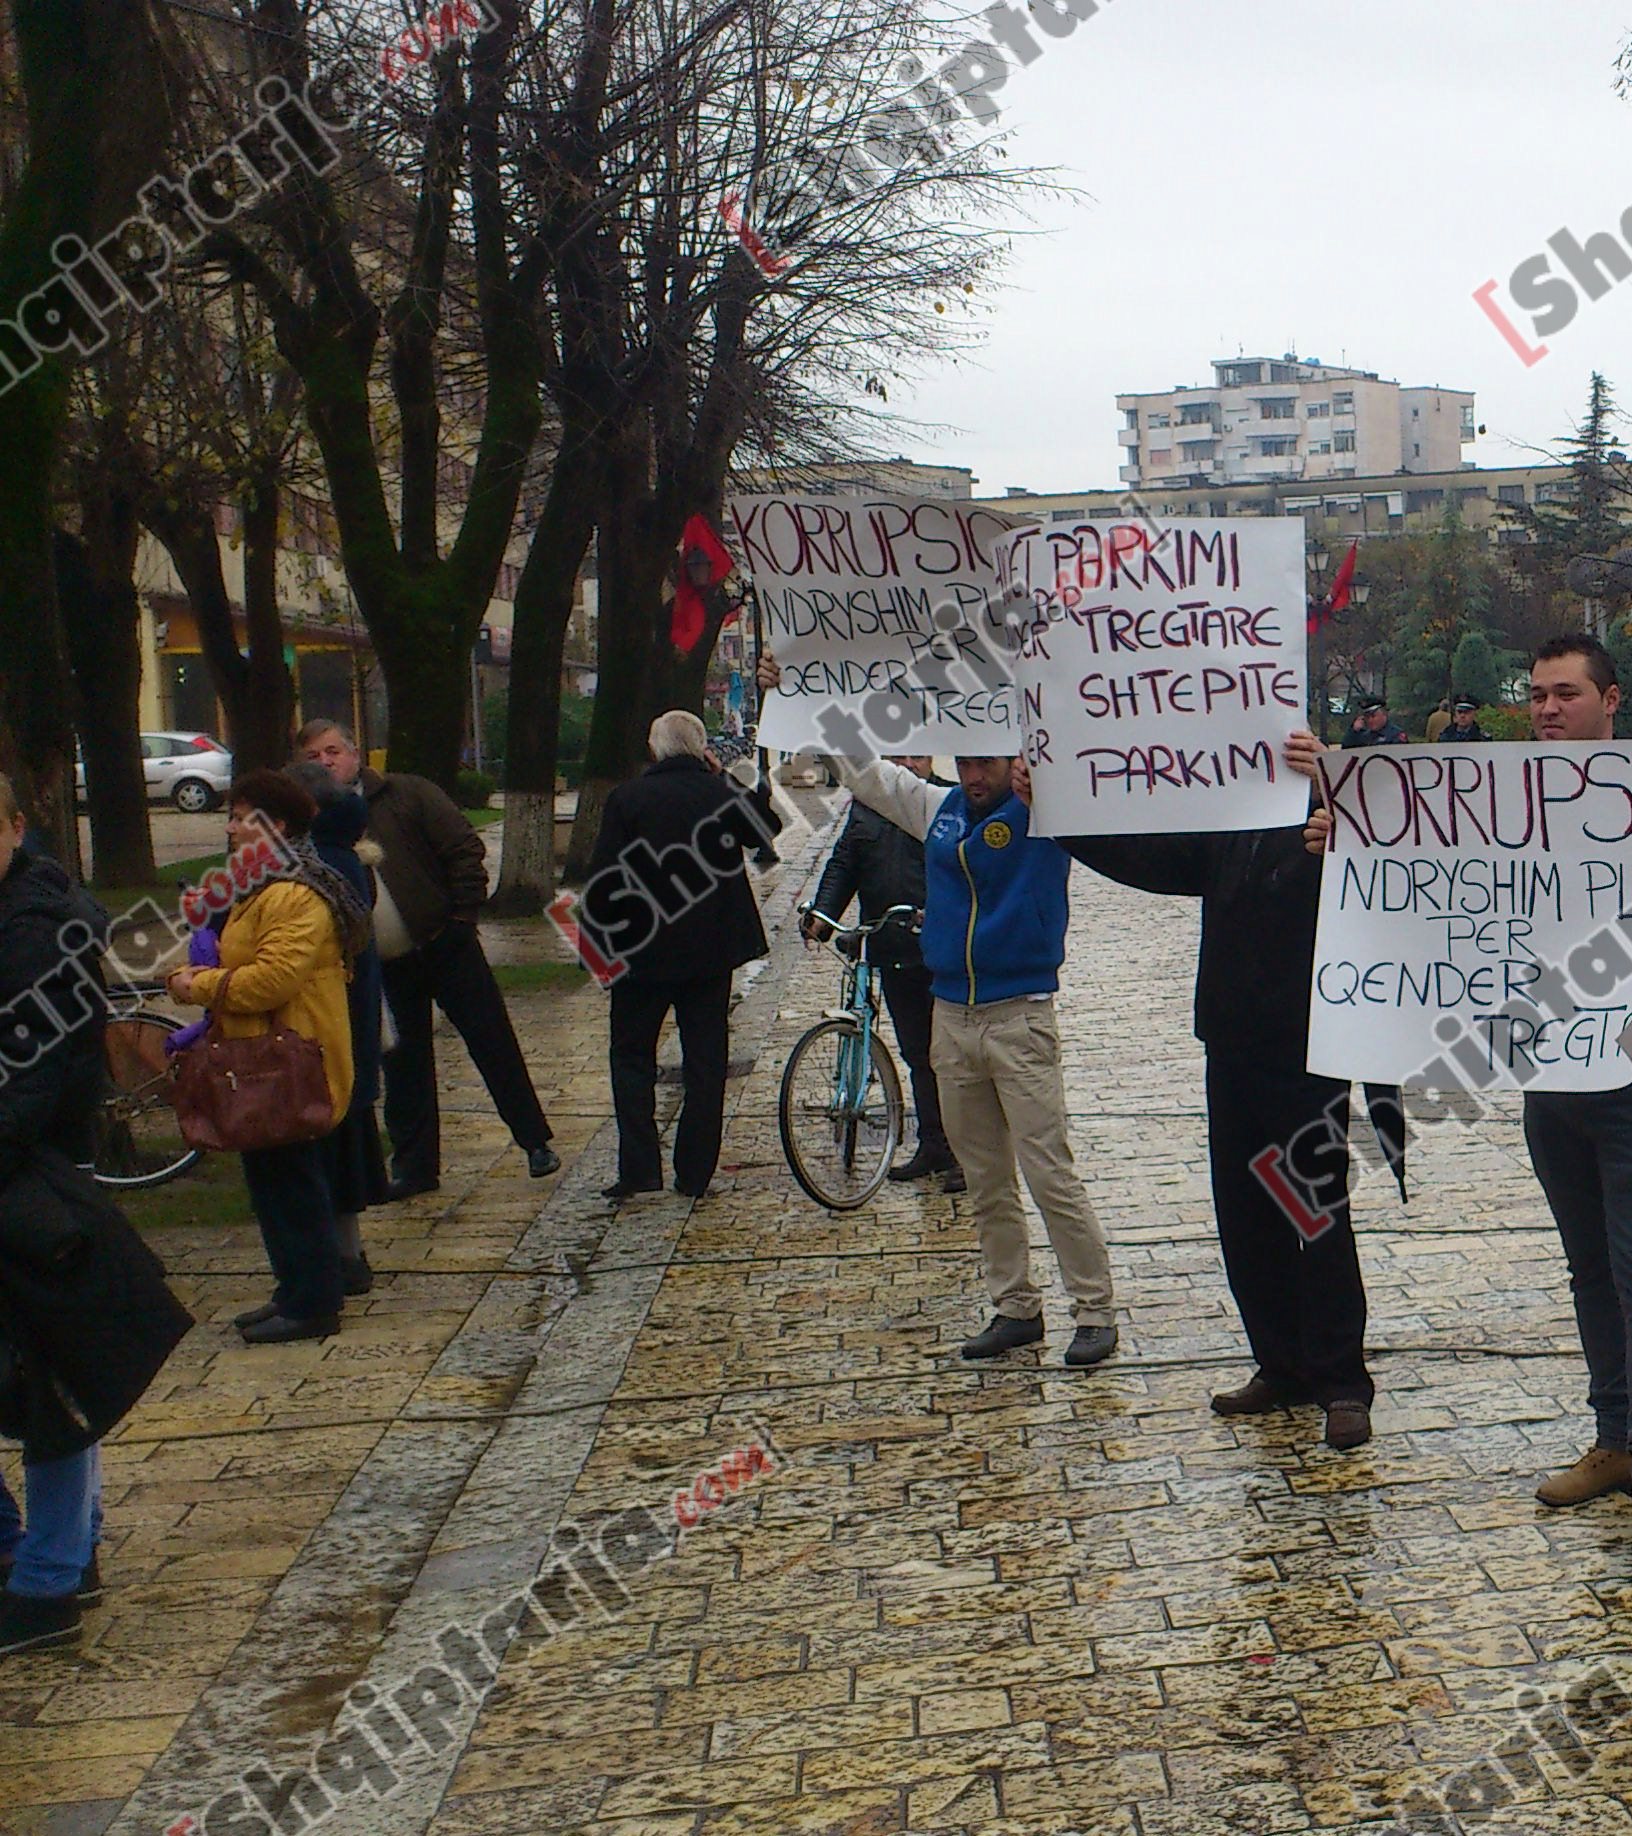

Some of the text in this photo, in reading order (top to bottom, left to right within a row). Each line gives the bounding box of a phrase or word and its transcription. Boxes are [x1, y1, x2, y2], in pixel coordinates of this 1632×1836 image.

[1046, 525, 1240, 592] PARKIMI
[763, 586, 936, 641] NDRYSHIM
[1029, 588, 1084, 626] PER
[1079, 602, 1284, 654] TREGTARE
[891, 628, 987, 664] PER
[777, 660, 909, 699] QENDER
[1079, 662, 1299, 720] SHTEPITE
[1076, 740, 1275, 798] PARKIM
[1340, 857, 1563, 922] NDRYSHIM
[1425, 915, 1536, 962] PER
[1316, 959, 1542, 1009] QENDER
